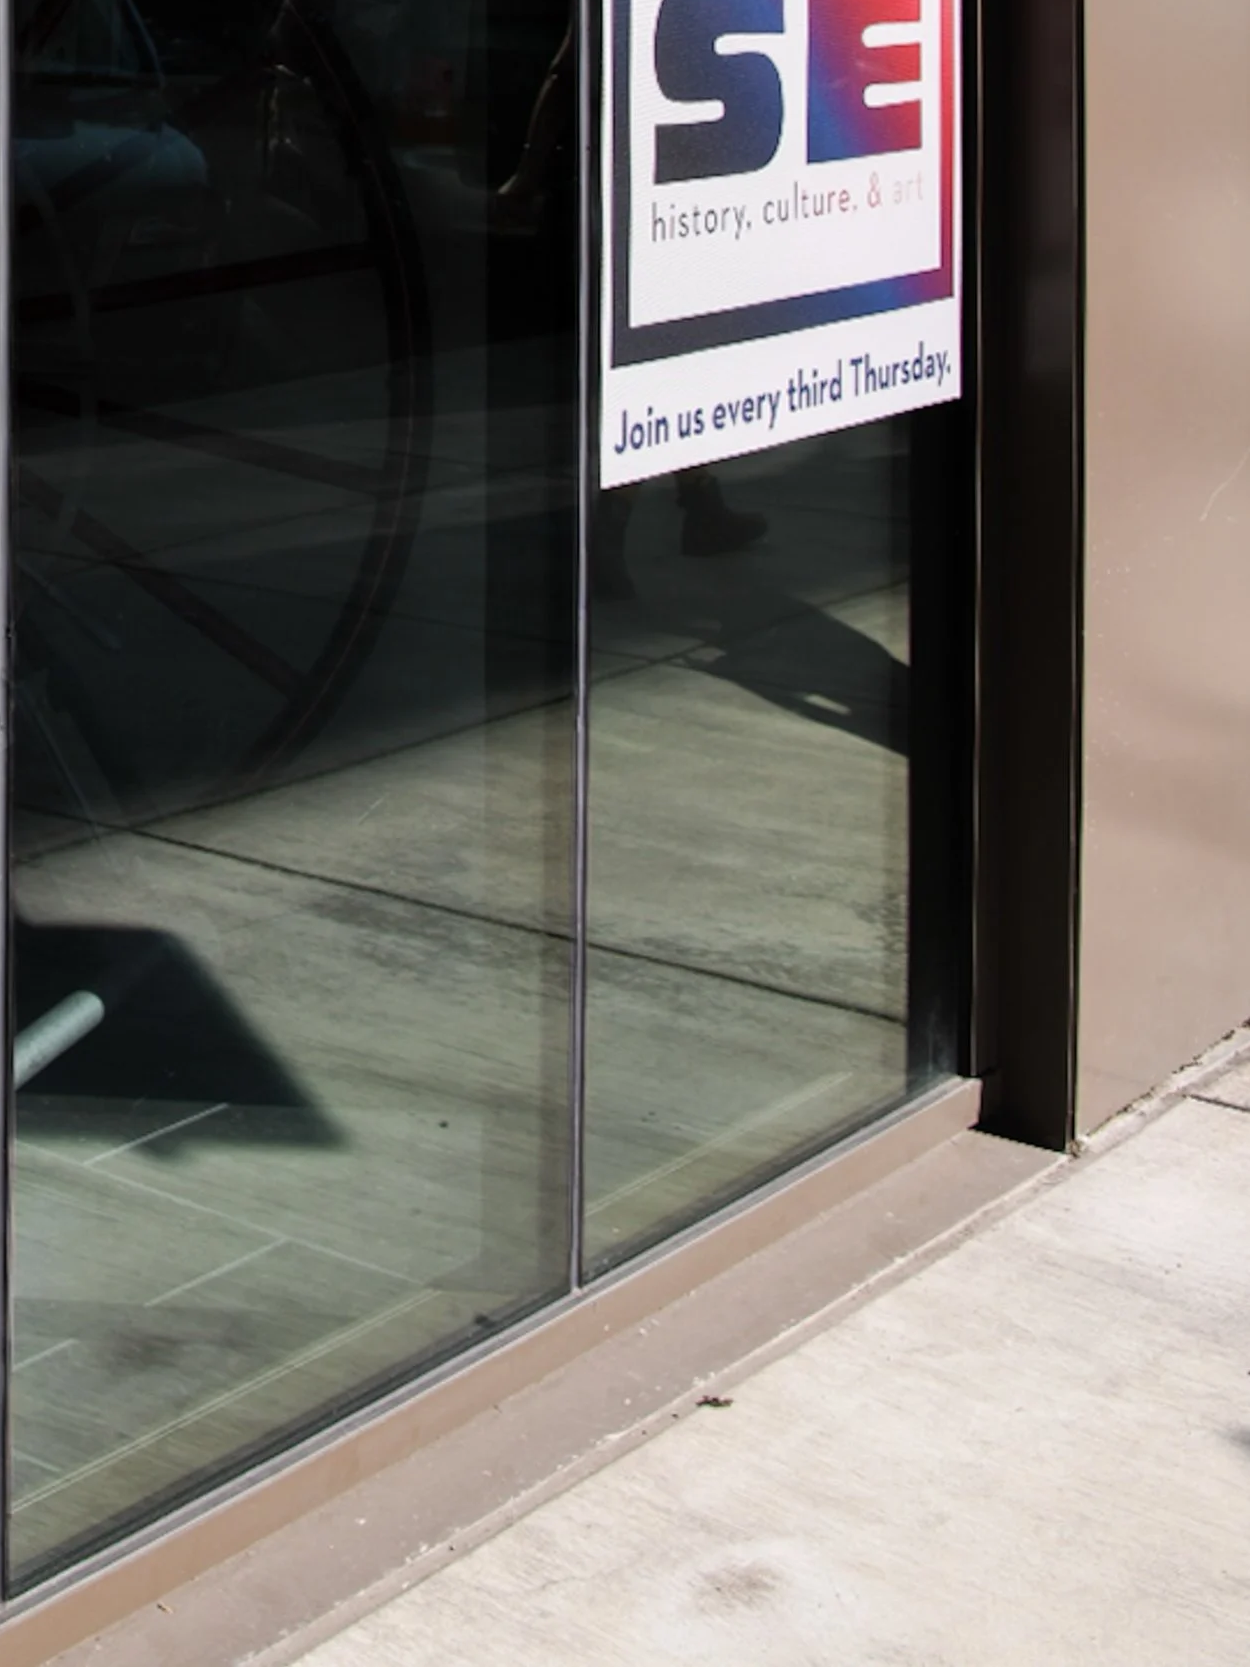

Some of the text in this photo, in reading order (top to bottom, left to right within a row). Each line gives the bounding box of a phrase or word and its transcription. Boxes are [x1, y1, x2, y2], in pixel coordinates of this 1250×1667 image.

[866, 171, 882, 209] &
[892, 170, 924, 206] art
[614, 340, 952, 454] Join us every third Thursday.
